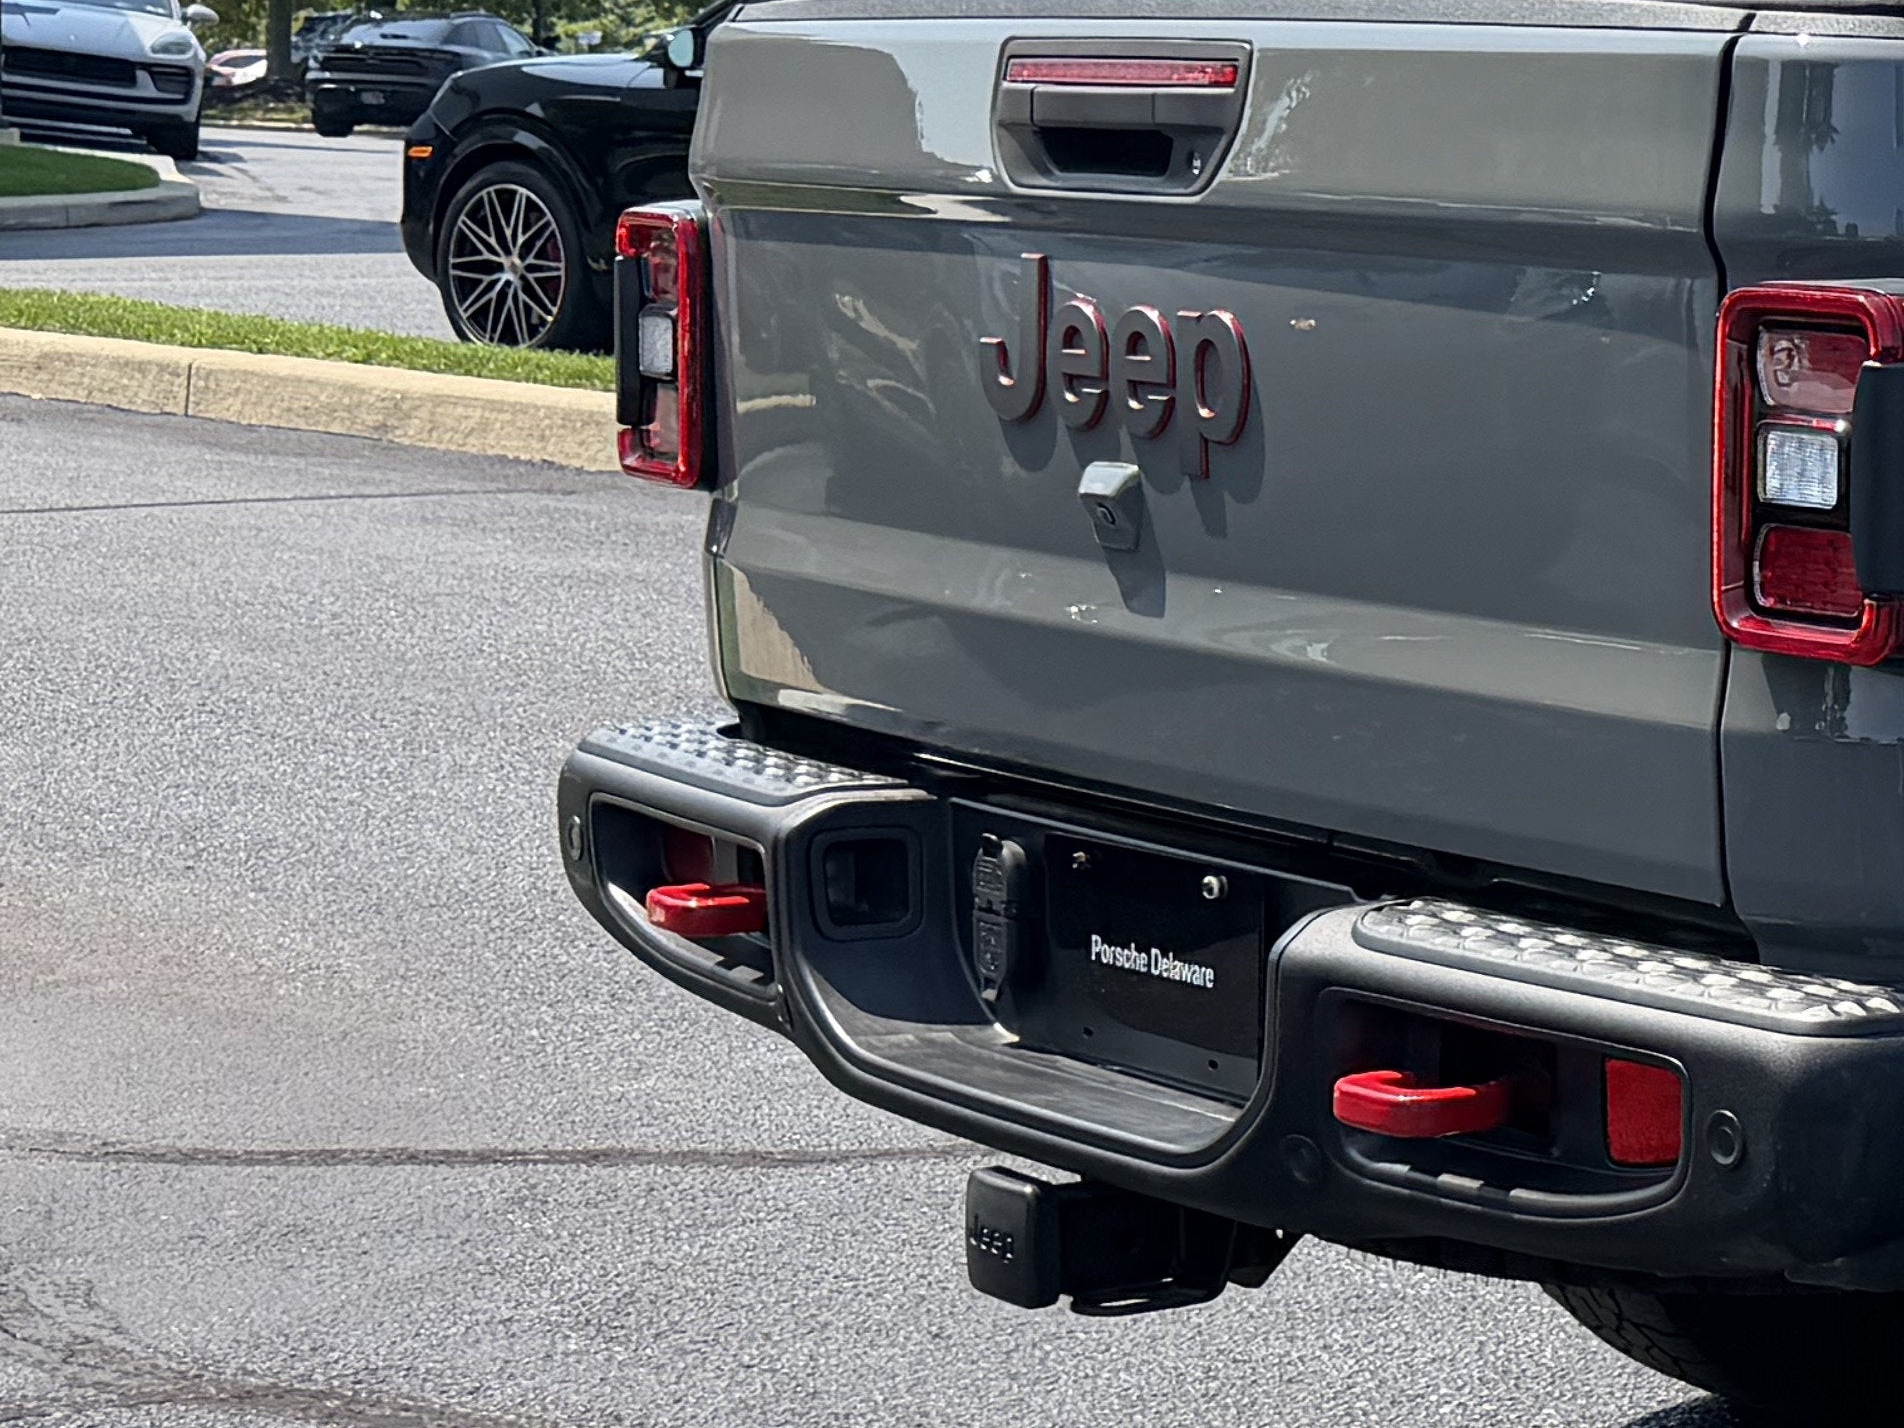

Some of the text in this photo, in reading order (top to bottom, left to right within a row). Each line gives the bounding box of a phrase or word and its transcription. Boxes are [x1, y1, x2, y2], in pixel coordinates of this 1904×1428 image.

[979, 252, 1251, 479] Jeep
[1091, 933, 1214, 989] Porsche Delaware
